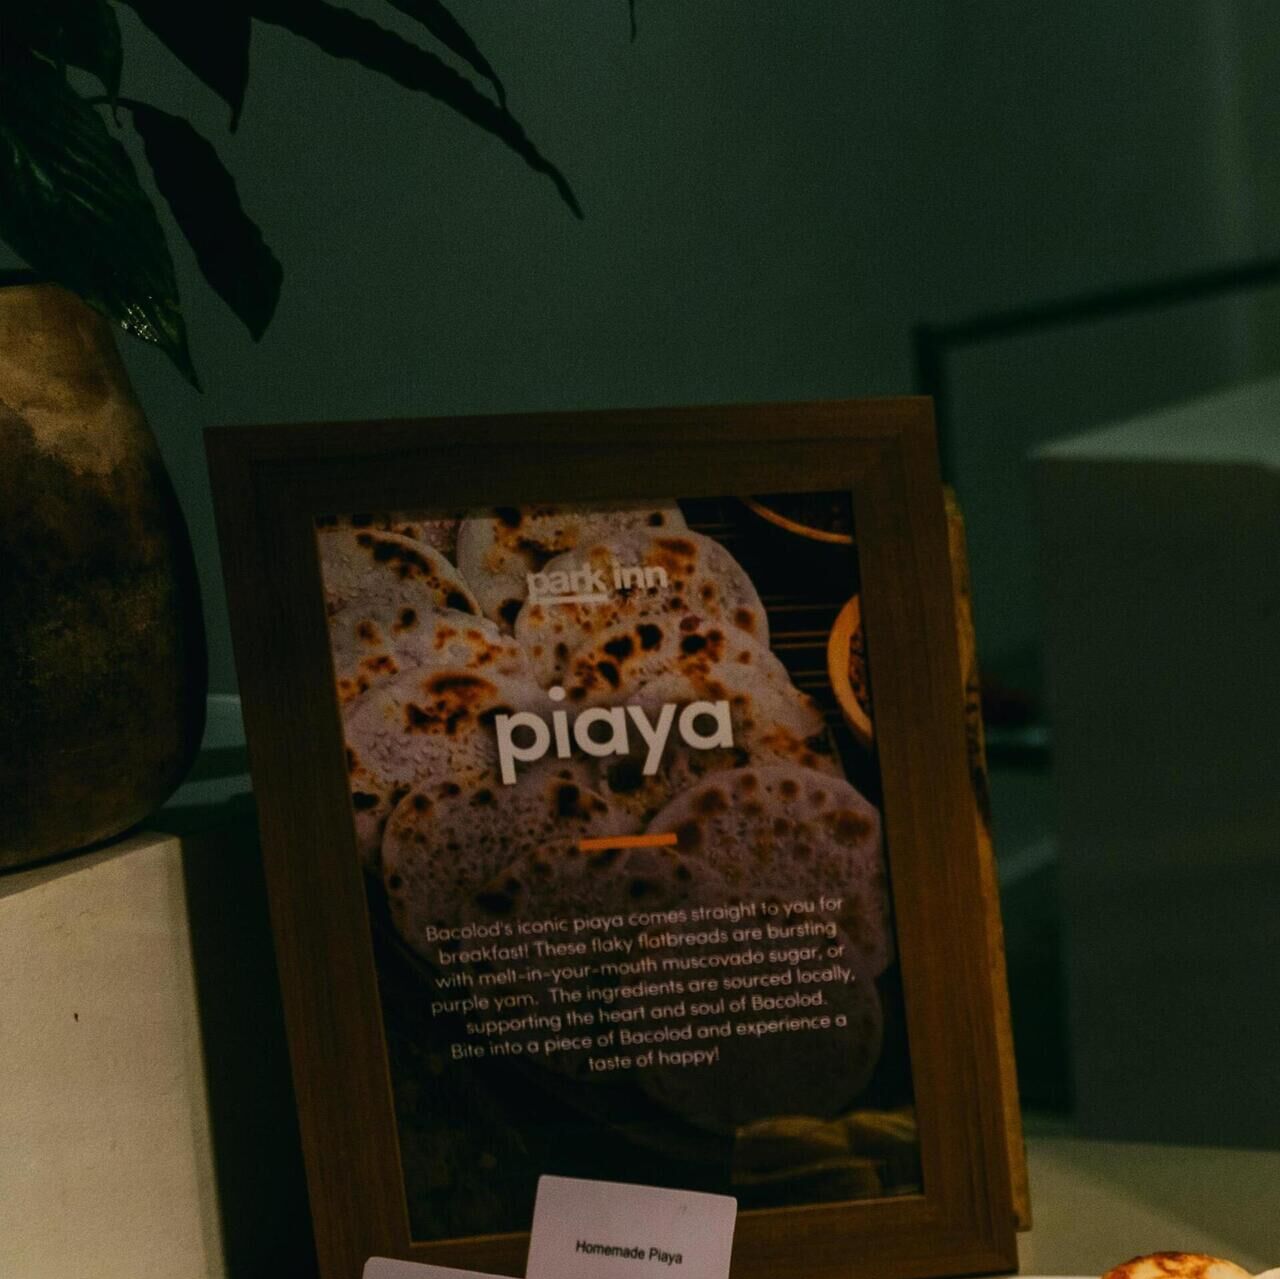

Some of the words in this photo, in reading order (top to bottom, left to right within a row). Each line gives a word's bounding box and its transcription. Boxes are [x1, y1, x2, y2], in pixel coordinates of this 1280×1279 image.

[527, 562, 608, 603] park
[612, 558, 668, 589] inn
[495, 686, 734, 785] piaya
[426, 921, 513, 942] Bacolod's
[518, 918, 568, 936] iconic
[573, 914, 624, 934] piaya
[628, 909, 686, 926] comes
[692, 901, 755, 922] straight
[761, 901, 778, 916] to
[784, 900, 815, 917] you
[820, 896, 843, 912] for
[438, 945, 528, 966] breakfast!
[534, 940, 586, 957] These
[592, 937, 633, 954] flaky
[638, 929, 728, 949] flatbreads
[732, 927, 762, 943] are
[767, 921, 837, 939] bursting
[435, 972, 473, 989] with
[479, 956, 657, 985] melt-in-your-mouth
[662, 949, 764, 971] muscovado
[769, 947, 822, 966] sugar,
[827, 944, 844, 959] or
[431, 995, 489, 1016] purple
[494, 993, 539, 1011] yam.
[548, 987, 582, 1004] The
[587, 979, 684, 1004] ingredients
[688, 977, 718, 993] are
[723, 969, 791, 989] sourced
[797, 964, 855, 984] locally,
[466, 1014, 561, 1036] supporting
[566, 1011, 594, 1025] the
[599, 1006, 645, 1022] heart
[651, 1002, 685, 1019] and
[691, 1000, 724, 1016] soul
[729, 997, 746, 1013] of
[751, 990, 827, 1011] Bacolod.
[451, 1043, 484, 1060] Bite
[490, 1041, 522, 1055] into
[527, 1041, 539, 1054] a
[544, 1035, 592, 1055] piece
[597, 1031, 614, 1046] of
[620, 1025, 692, 1046] Bacolod
[697, 1021, 731, 1039] and
[736, 1015, 831, 1038] experience
[835, 1015, 847, 1027] a
[588, 1057, 631, 1072] taste
[636, 1051, 654, 1067] of
[658, 1046, 719, 1067] happy!
[576, 1240, 645, 1260] Homemade
[648, 1247, 683, 1266] Piaya
